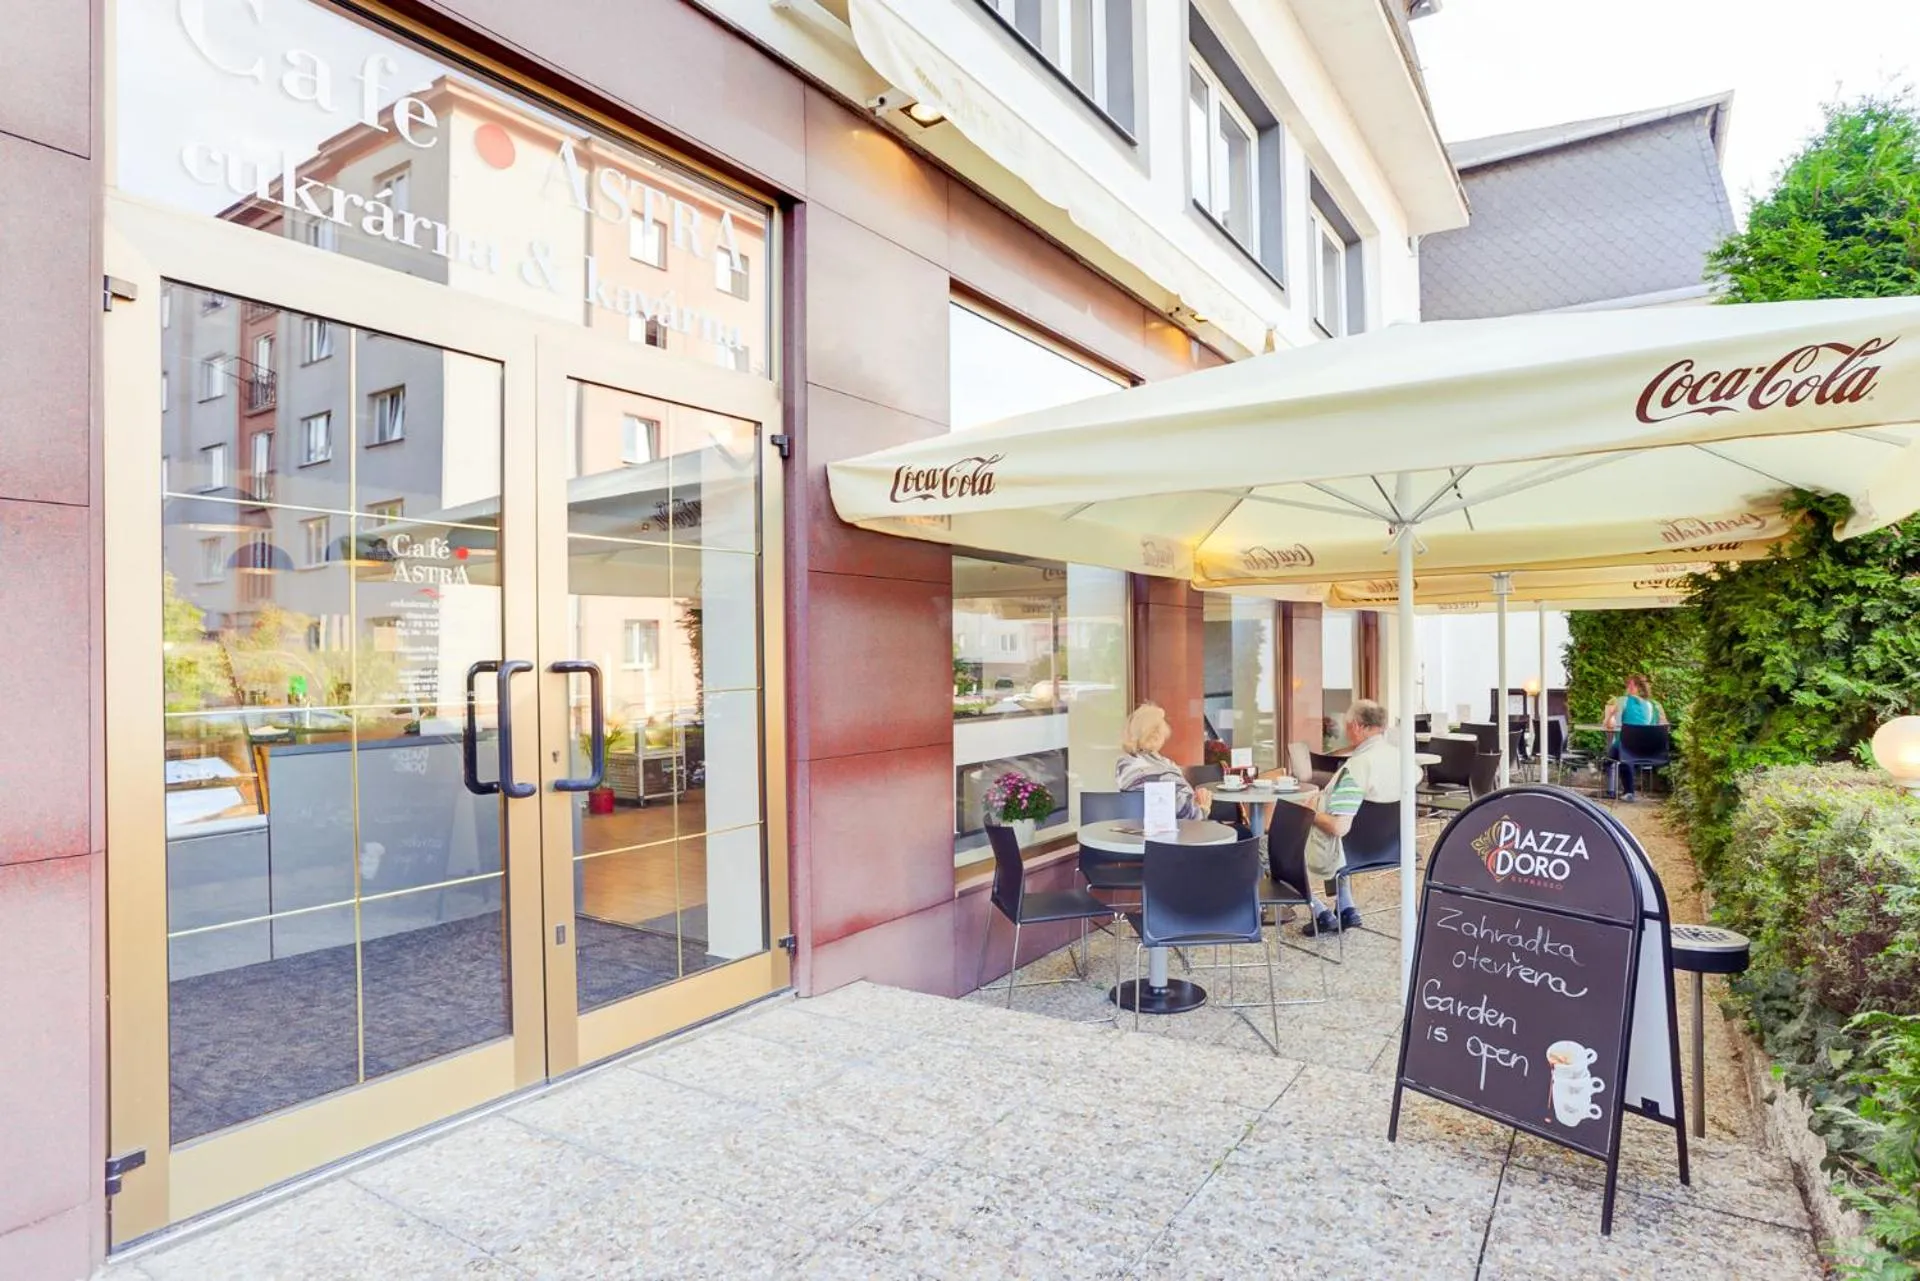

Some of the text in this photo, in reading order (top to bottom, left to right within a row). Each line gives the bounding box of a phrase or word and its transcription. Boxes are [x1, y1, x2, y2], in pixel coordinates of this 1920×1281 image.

[540, 136, 749, 275] ASTRA
[178, 143, 746, 351] cukrárna & kavárna
[1635, 335, 1901, 424] Coca-Cola
[890, 452, 1008, 503] Coca-Cola
[390, 534, 451, 560] Café
[393, 560, 470, 585] ASTRA
[1499, 820, 1590, 860] PIAZZA
[1437, 907, 1584, 966] Zahrádka
[1452, 945, 1588, 998] otevřena
[1422, 978, 1517, 1035] Garden
[1426, 1021, 1449, 1044] is
